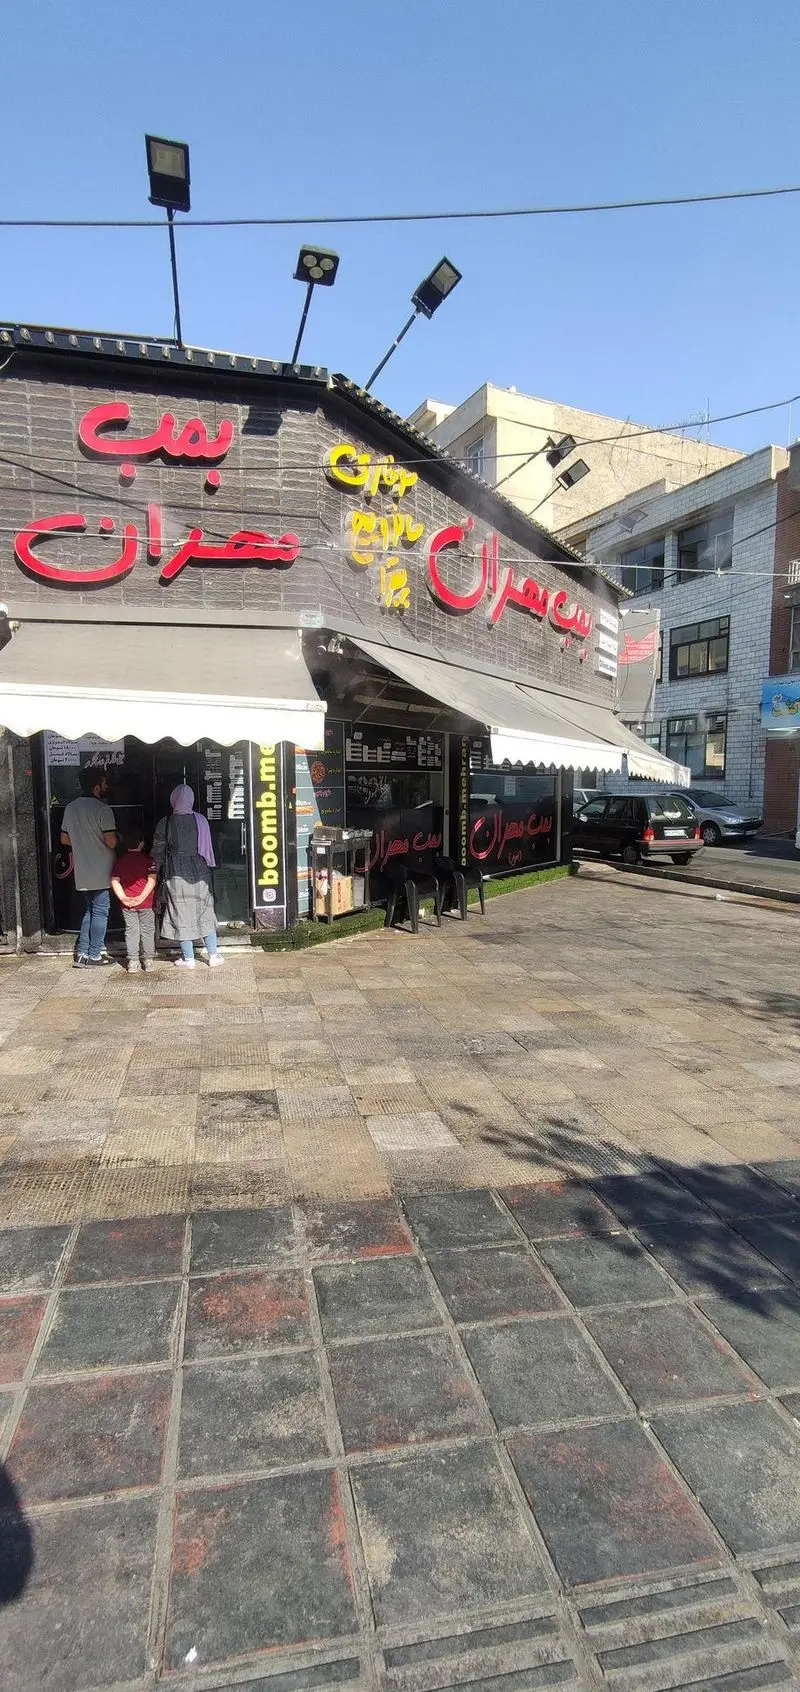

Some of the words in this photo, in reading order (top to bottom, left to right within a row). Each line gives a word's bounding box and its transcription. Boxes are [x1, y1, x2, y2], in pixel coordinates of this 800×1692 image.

[79, 401, 234, 487] بمب
[14, 503, 300, 582] مهران
[425, 515, 549, 625] مهران
[548, 589, 593, 662] بمب
[469, 809, 524, 860] مهران
[527, 812, 553, 850] بمب
